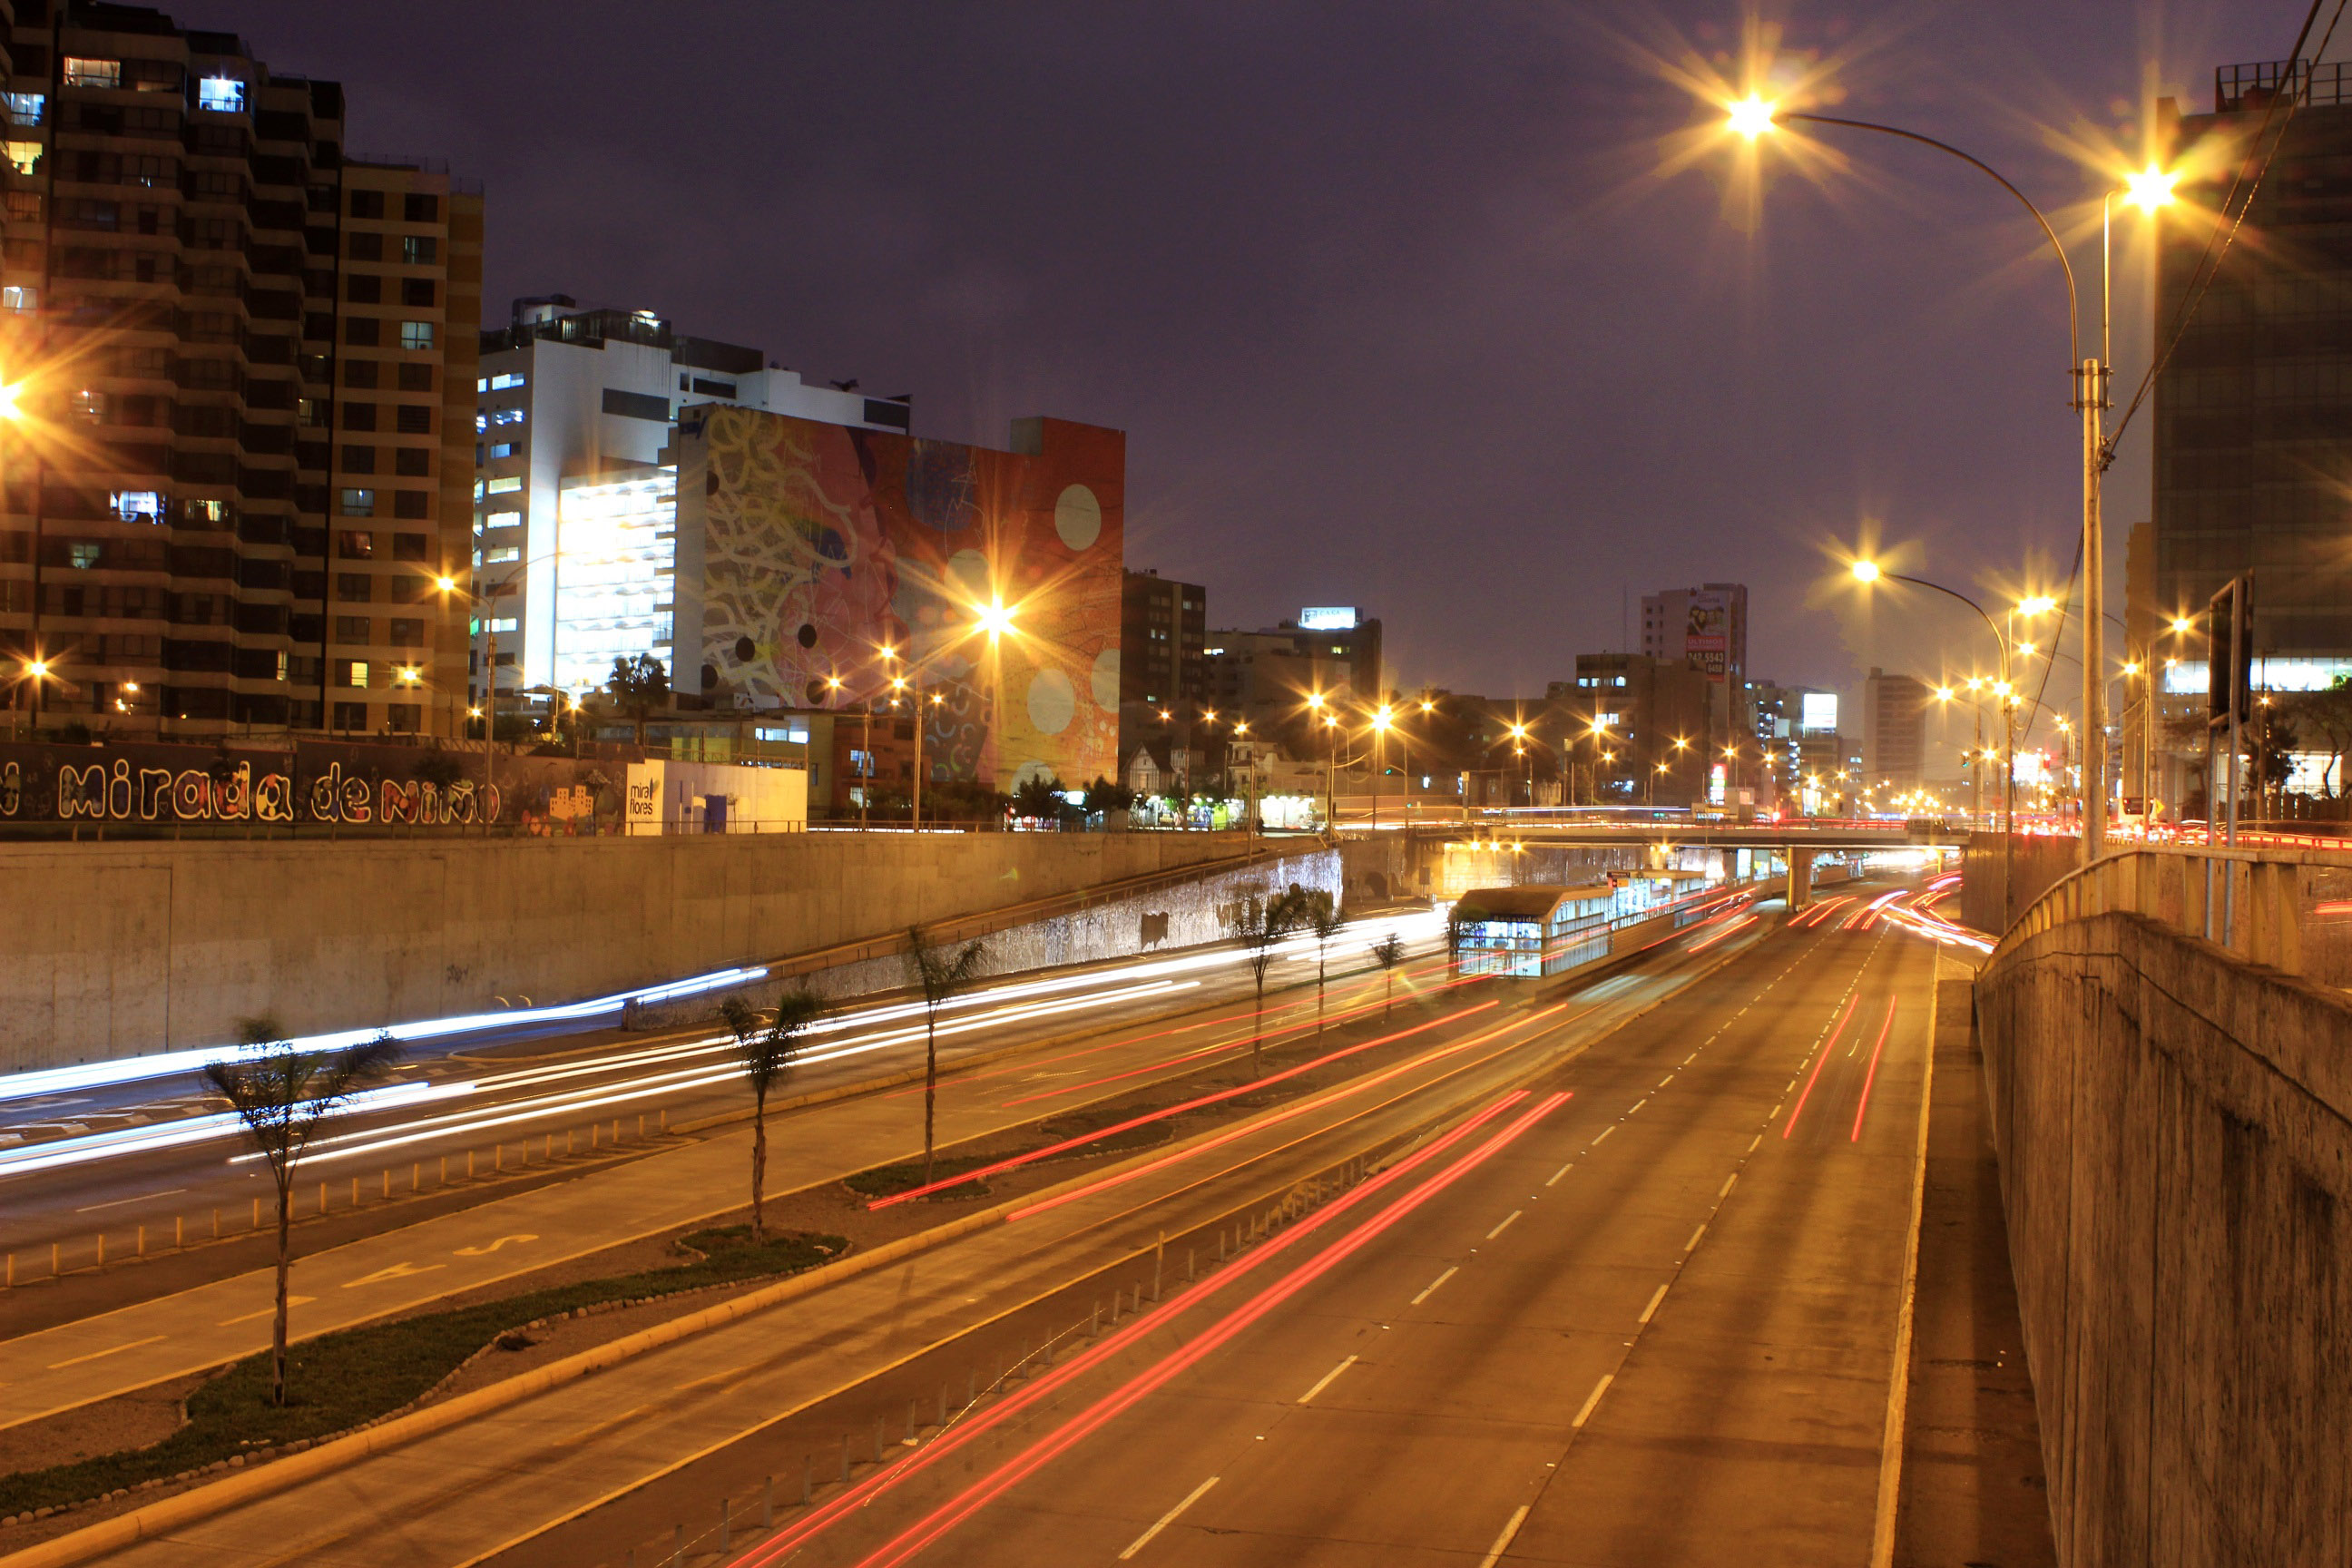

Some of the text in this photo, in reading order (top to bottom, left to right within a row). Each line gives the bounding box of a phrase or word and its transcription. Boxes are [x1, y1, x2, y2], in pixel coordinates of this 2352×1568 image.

[311, 761, 371, 822] de
[630, 782, 650, 799] mira
[630, 799, 653, 815] flores
